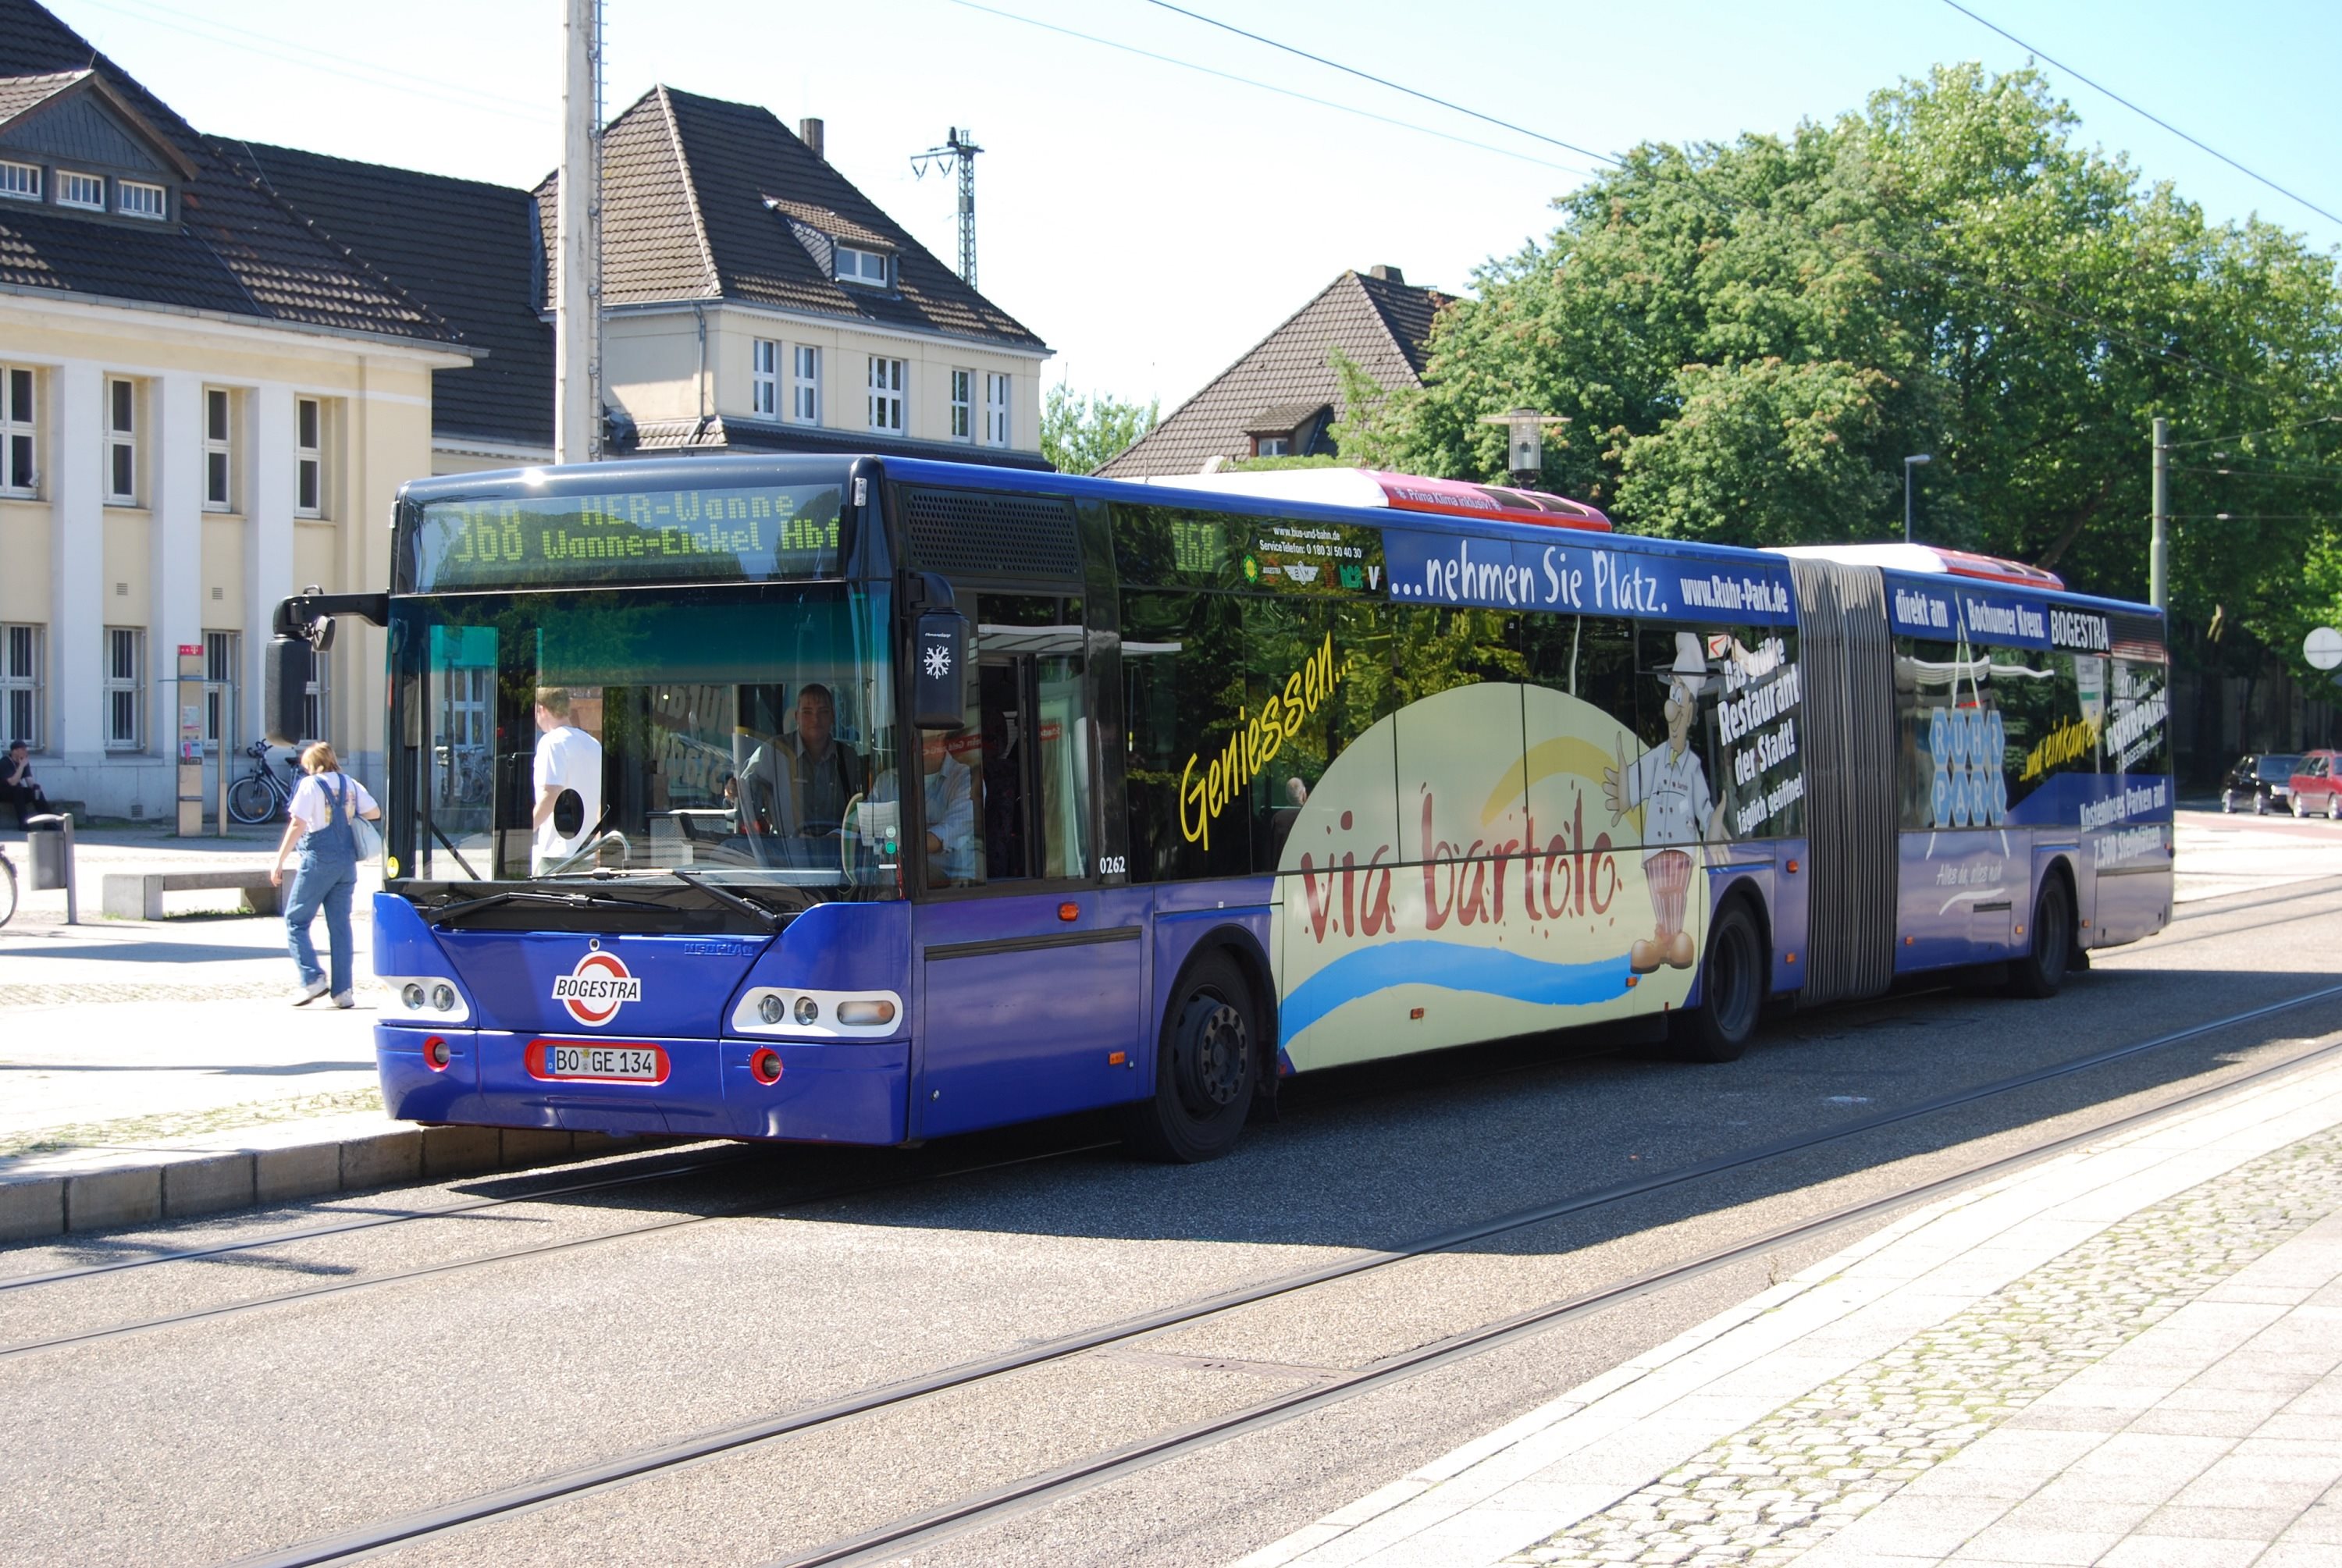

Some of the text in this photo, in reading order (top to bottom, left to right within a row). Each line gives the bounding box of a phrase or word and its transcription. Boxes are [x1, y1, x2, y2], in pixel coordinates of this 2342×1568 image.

[581, 492, 794, 526] HER-Wanne
[1408, 488, 1492, 510] Prima Klima inklusiv!
[453, 500, 523, 563] 368
[543, 517, 840, 560] Wanne-Eickel Hbf
[1171, 521, 1215, 572] 368
[1272, 526, 1341, 541] www.bus-und-bahn.de
[1306, 545, 1312, 555] 0
[1313, 545, 1326, 556] 180
[1334, 546, 1343, 557] 50
[1344, 546, 1352, 558] 40
[1353, 547, 1361, 559] 30
[1543, 546, 1582, 609] Sie
[1592, 549, 1668, 613] Platz.
[1680, 575, 1789, 614] www.Ruhr-Park.de
[1895, 588, 2045, 638] direkt am Bochumer Kreuz
[2050, 610, 2109, 651] BOGESTRA
[1724, 659, 1747, 694] Das
[1717, 663, 1800, 747] Restaurant
[2105, 687, 2169, 757] RUHRPARK
[1735, 718, 1796, 787] der Stadt!
[1934, 719, 2001, 757] RUHR
[1737, 772, 1804, 835] täglich geöffnet
[1935, 779, 2002, 814] PARK
[2079, 778, 2166, 834] Kostenloses Parken auf
[1099, 855, 1126, 875] 0262
[1300, 783, 1622, 944] via bartolo
[557, 979, 638, 1000] BOGESTRA
[556, 1050, 579, 1071] BO
[592, 1051, 615, 1072] GE
[620, 1051, 653, 1074] 134
